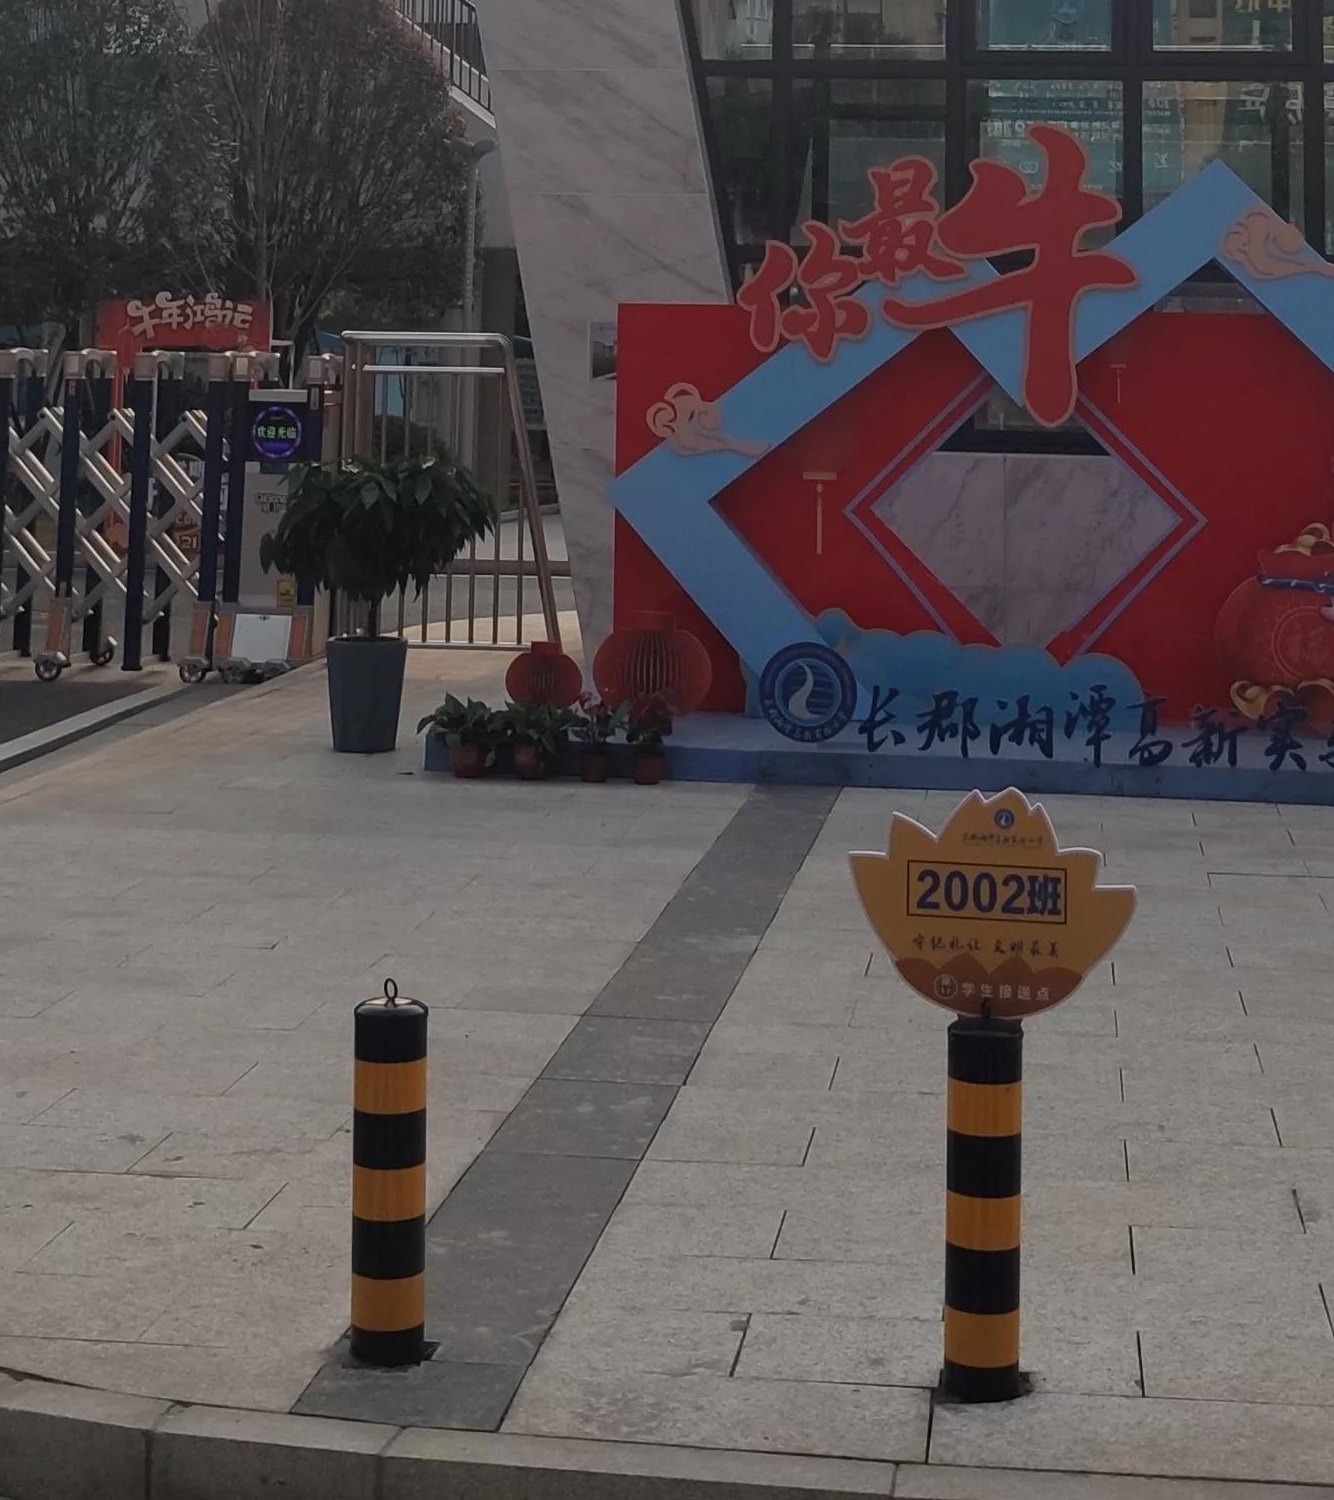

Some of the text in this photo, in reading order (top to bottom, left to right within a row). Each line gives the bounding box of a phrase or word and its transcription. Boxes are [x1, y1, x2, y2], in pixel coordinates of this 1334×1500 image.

[739, 124, 1137, 428] 你最牛
[127, 291, 254, 339] 牛年鸿运
[257, 425, 297, 439] 欢迎光临
[916, 868, 1062, 916] 2002班
[961, 981, 1051, 1002] 学生接送点
